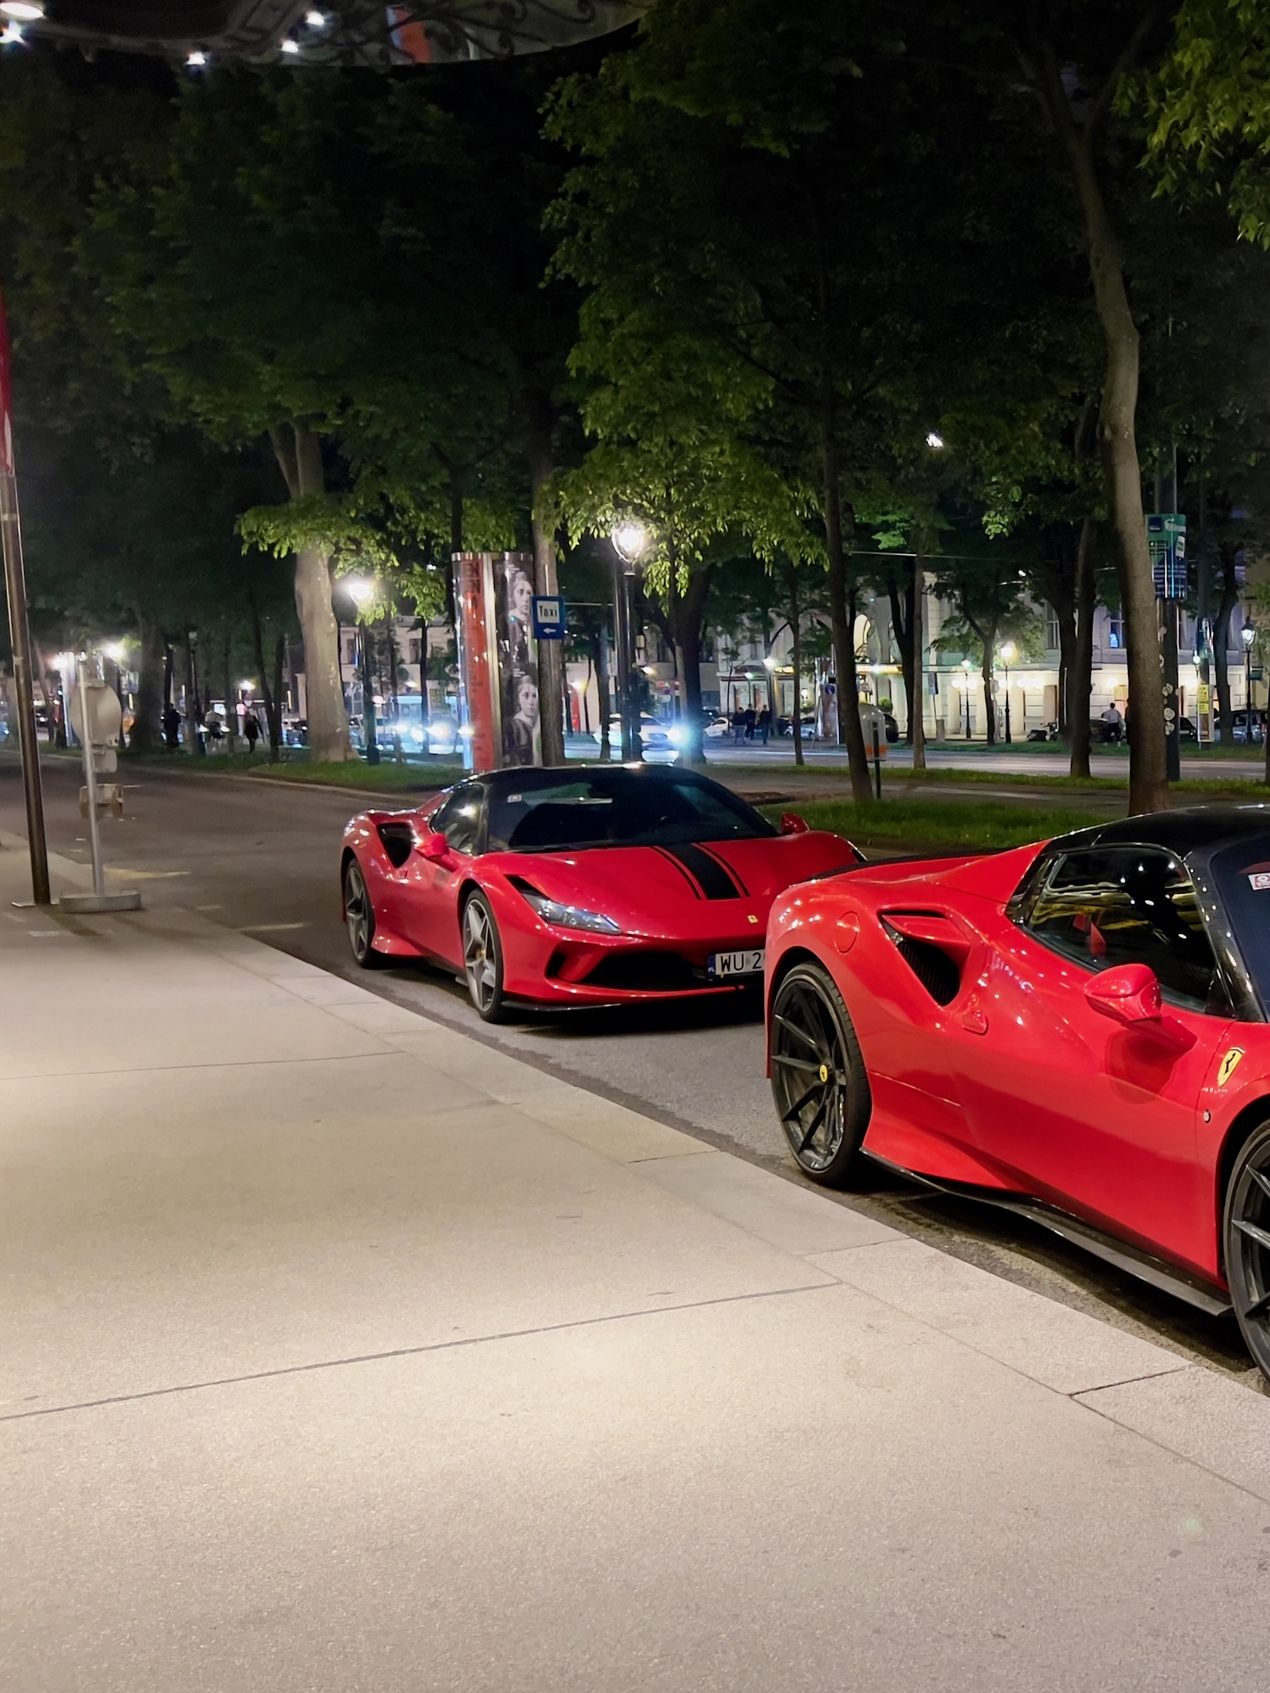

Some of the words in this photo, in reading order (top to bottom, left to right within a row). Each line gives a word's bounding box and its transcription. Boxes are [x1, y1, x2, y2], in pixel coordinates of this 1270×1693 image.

[539, 605, 558, 617] Taxi
[720, 953, 745, 973] WU
[752, 952, 766, 970] 2
